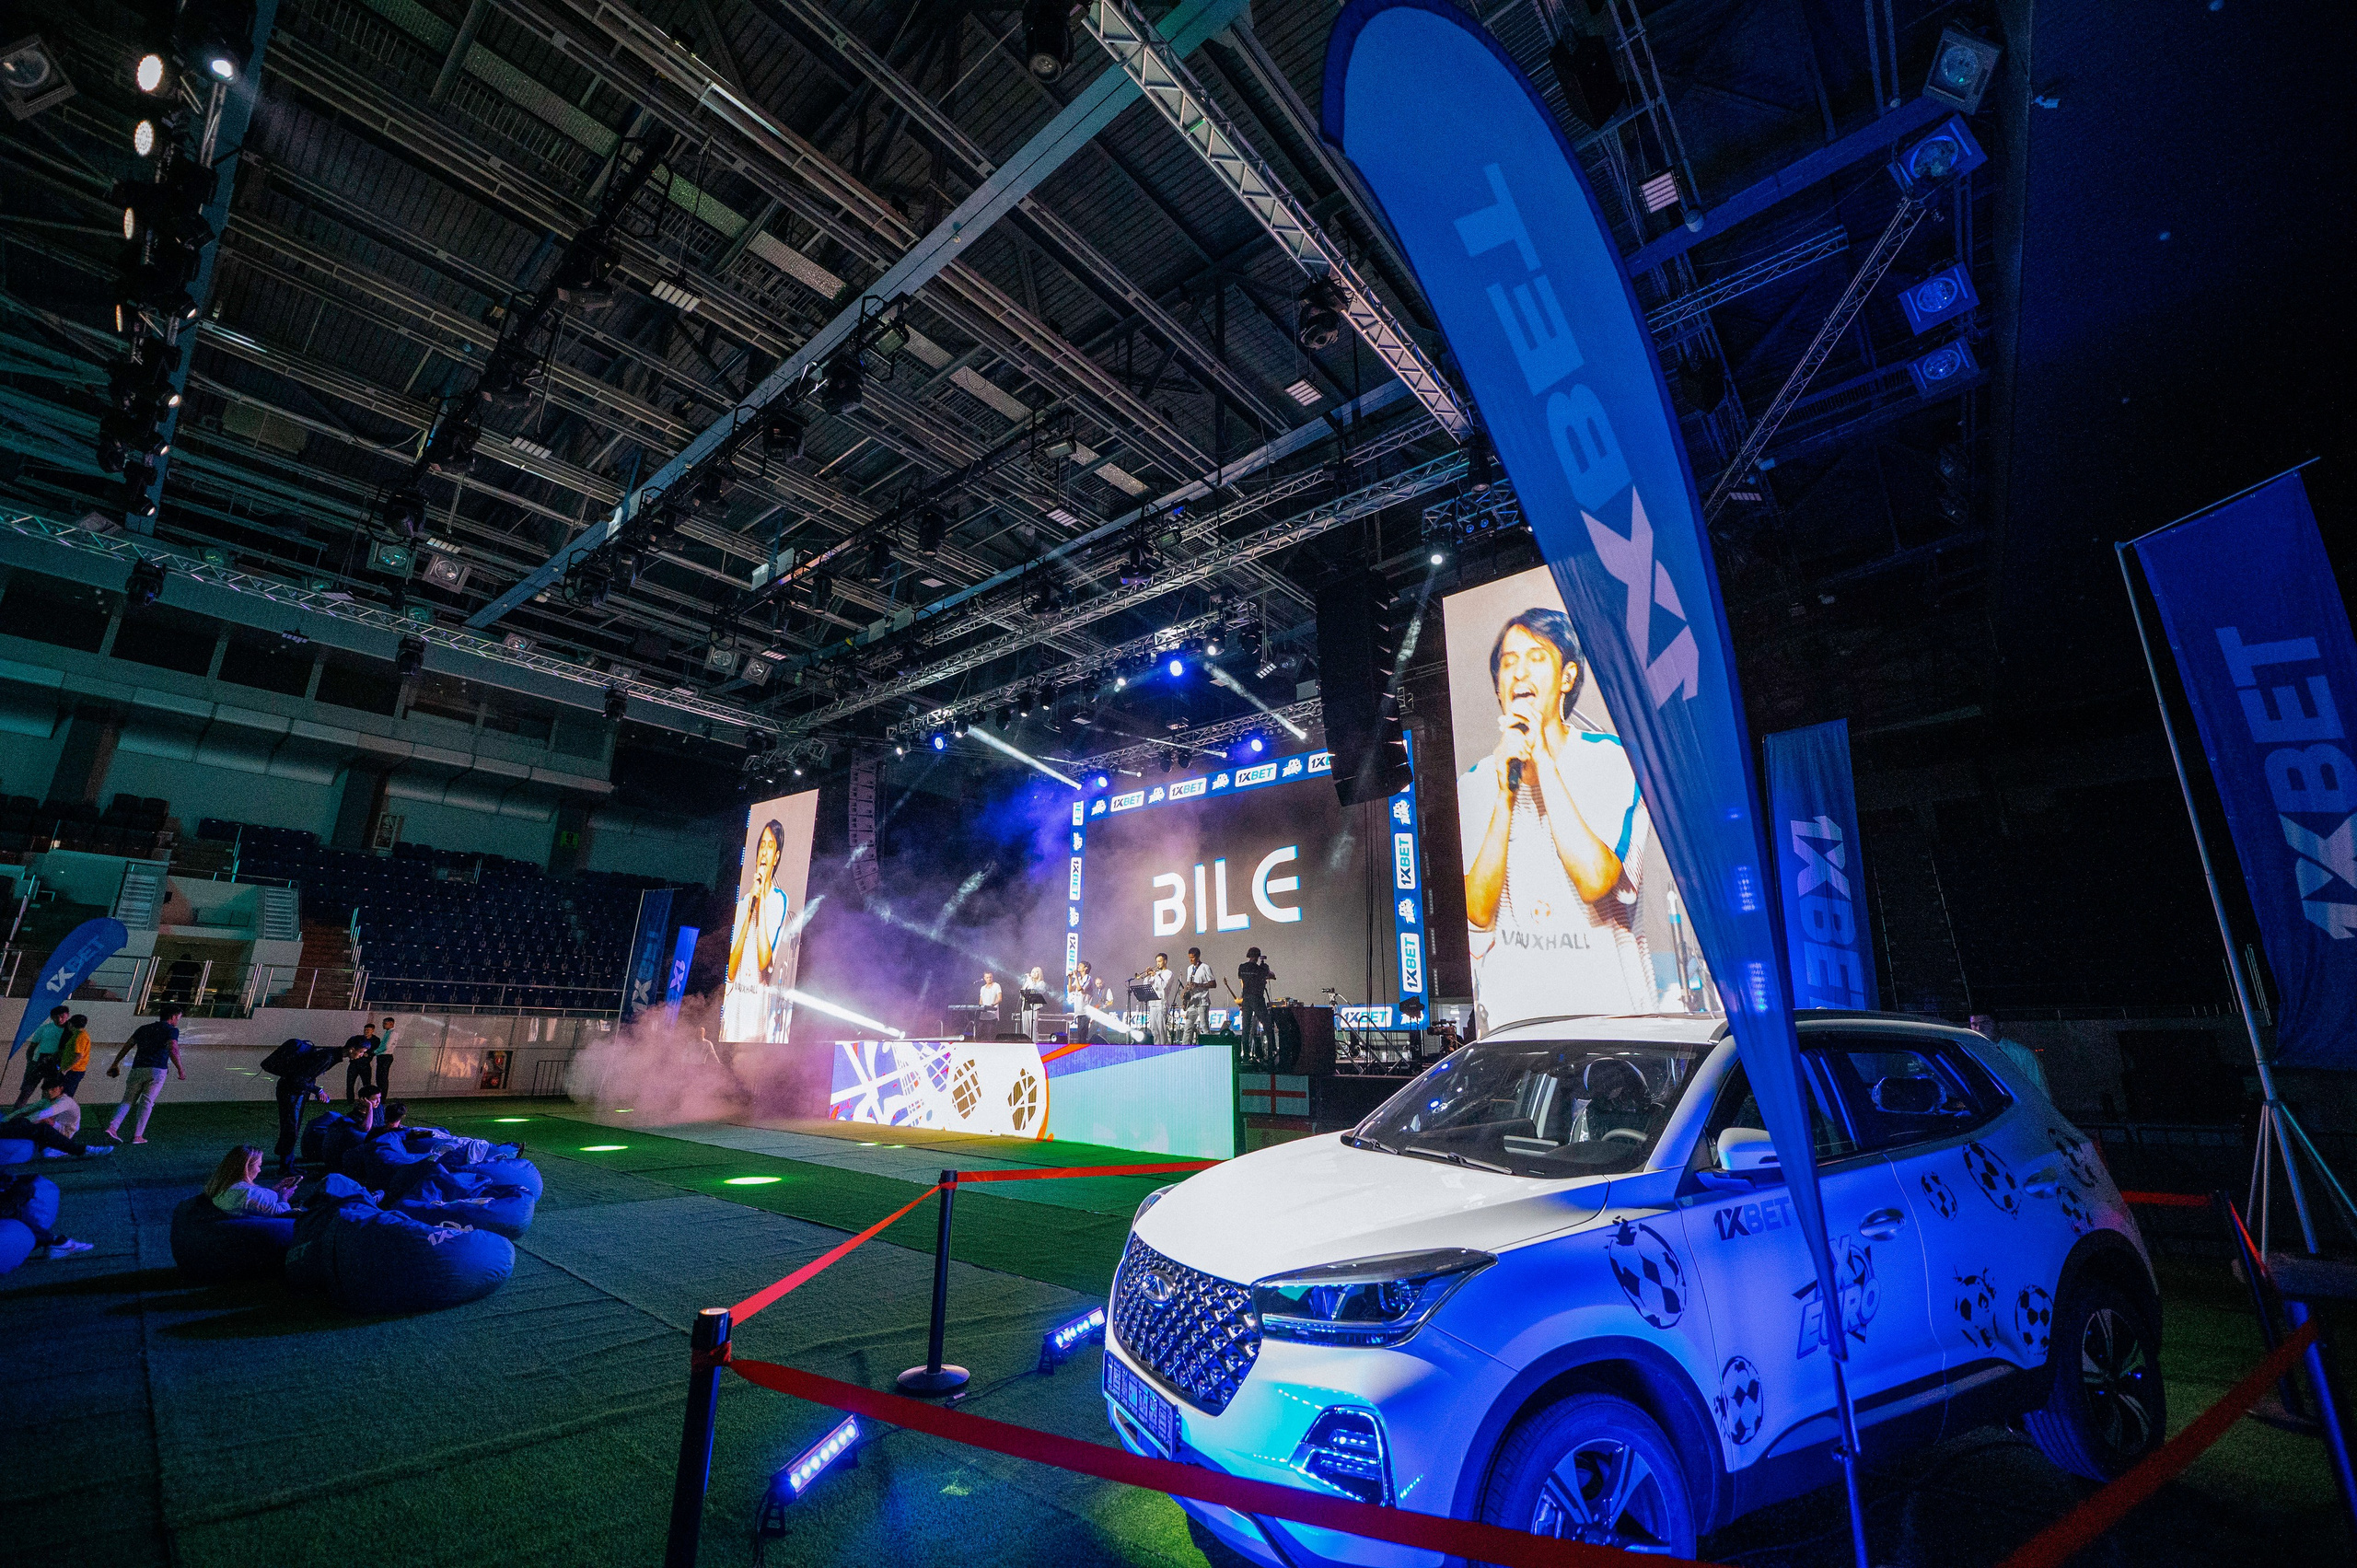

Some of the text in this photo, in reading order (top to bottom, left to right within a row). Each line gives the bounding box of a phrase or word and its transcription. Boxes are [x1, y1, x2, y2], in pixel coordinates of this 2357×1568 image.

[1171, 782, 1203, 796] 1XBET
[1237, 767, 1273, 783] 1XBET
[2215, 626, 2357, 939] 1XBET
[1113, 795, 1142, 808] 1XBET
[1399, 837, 1411, 887] 1XBET
[1153, 845, 1302, 936] BILE
[1404, 937, 1418, 988] 1XBET
[1502, 929, 1590, 950] VAUXHALL
[46, 935, 104, 993] 1XBET
[1713, 1196, 1791, 1241] 1XBET
